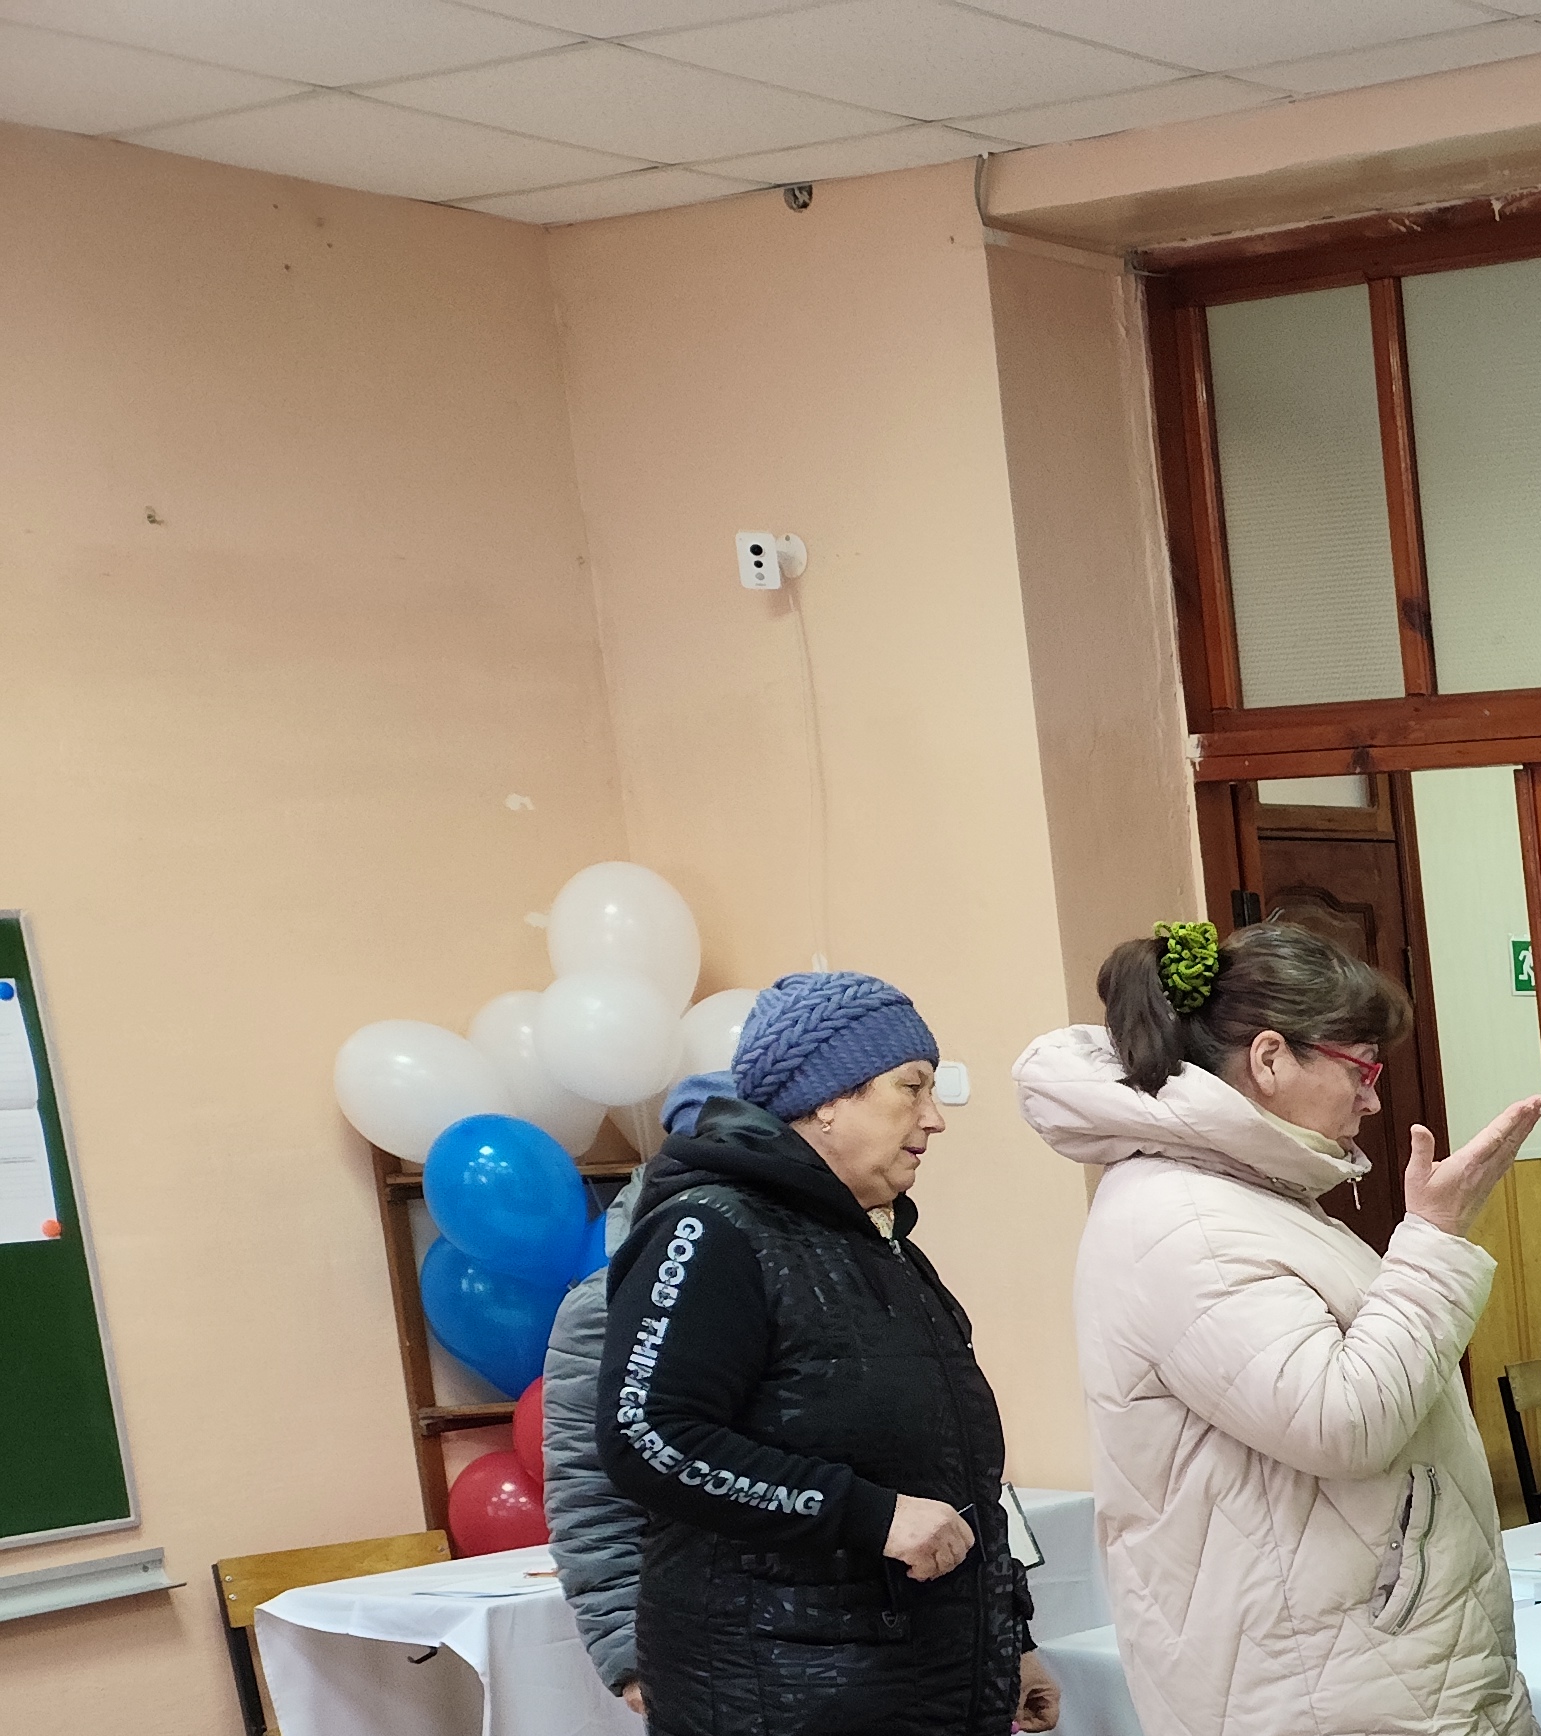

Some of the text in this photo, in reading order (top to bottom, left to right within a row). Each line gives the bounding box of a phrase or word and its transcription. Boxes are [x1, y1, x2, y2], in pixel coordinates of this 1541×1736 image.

[617, 1216, 825, 1517] GOOD THINGS ARE COMING
